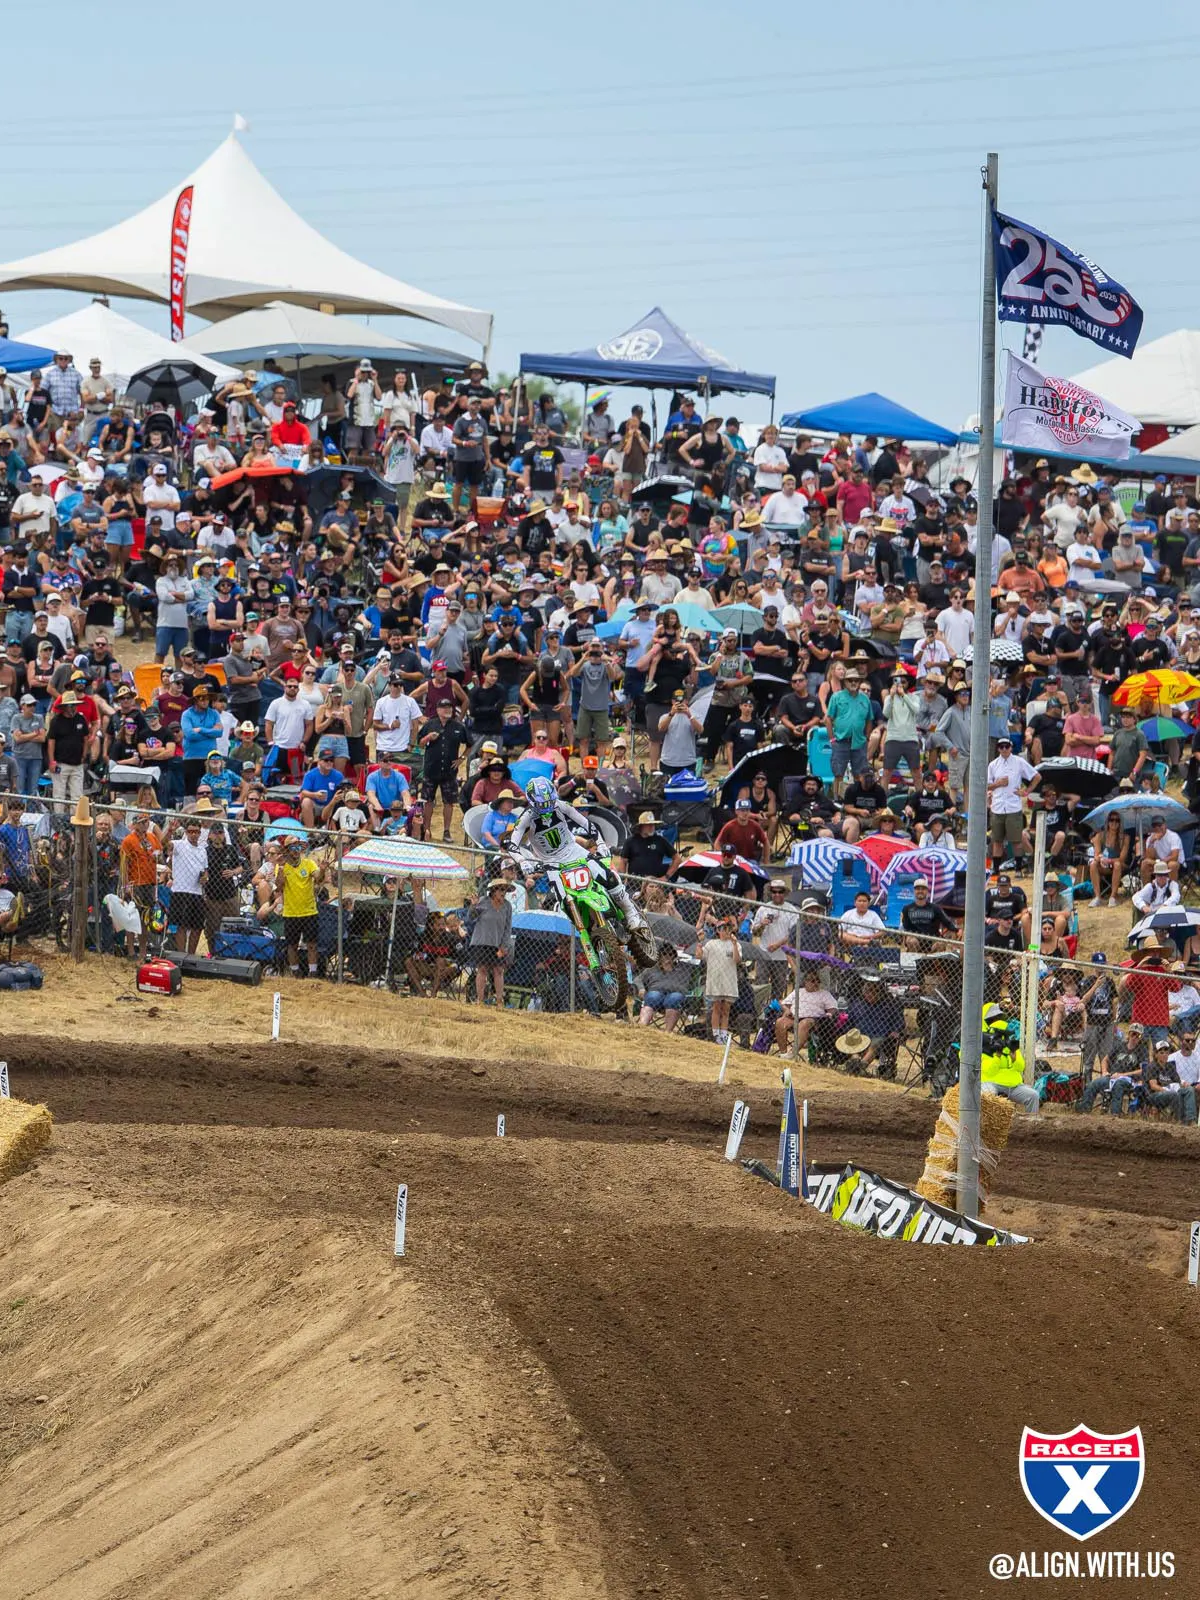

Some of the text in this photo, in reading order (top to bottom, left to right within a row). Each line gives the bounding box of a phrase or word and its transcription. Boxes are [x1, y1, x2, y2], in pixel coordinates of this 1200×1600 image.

[1030, 304, 1106, 341] ANNIVERSARY
[565, 869, 589, 890] 10
[790, 1133, 798, 1188] MOTOCROSS
